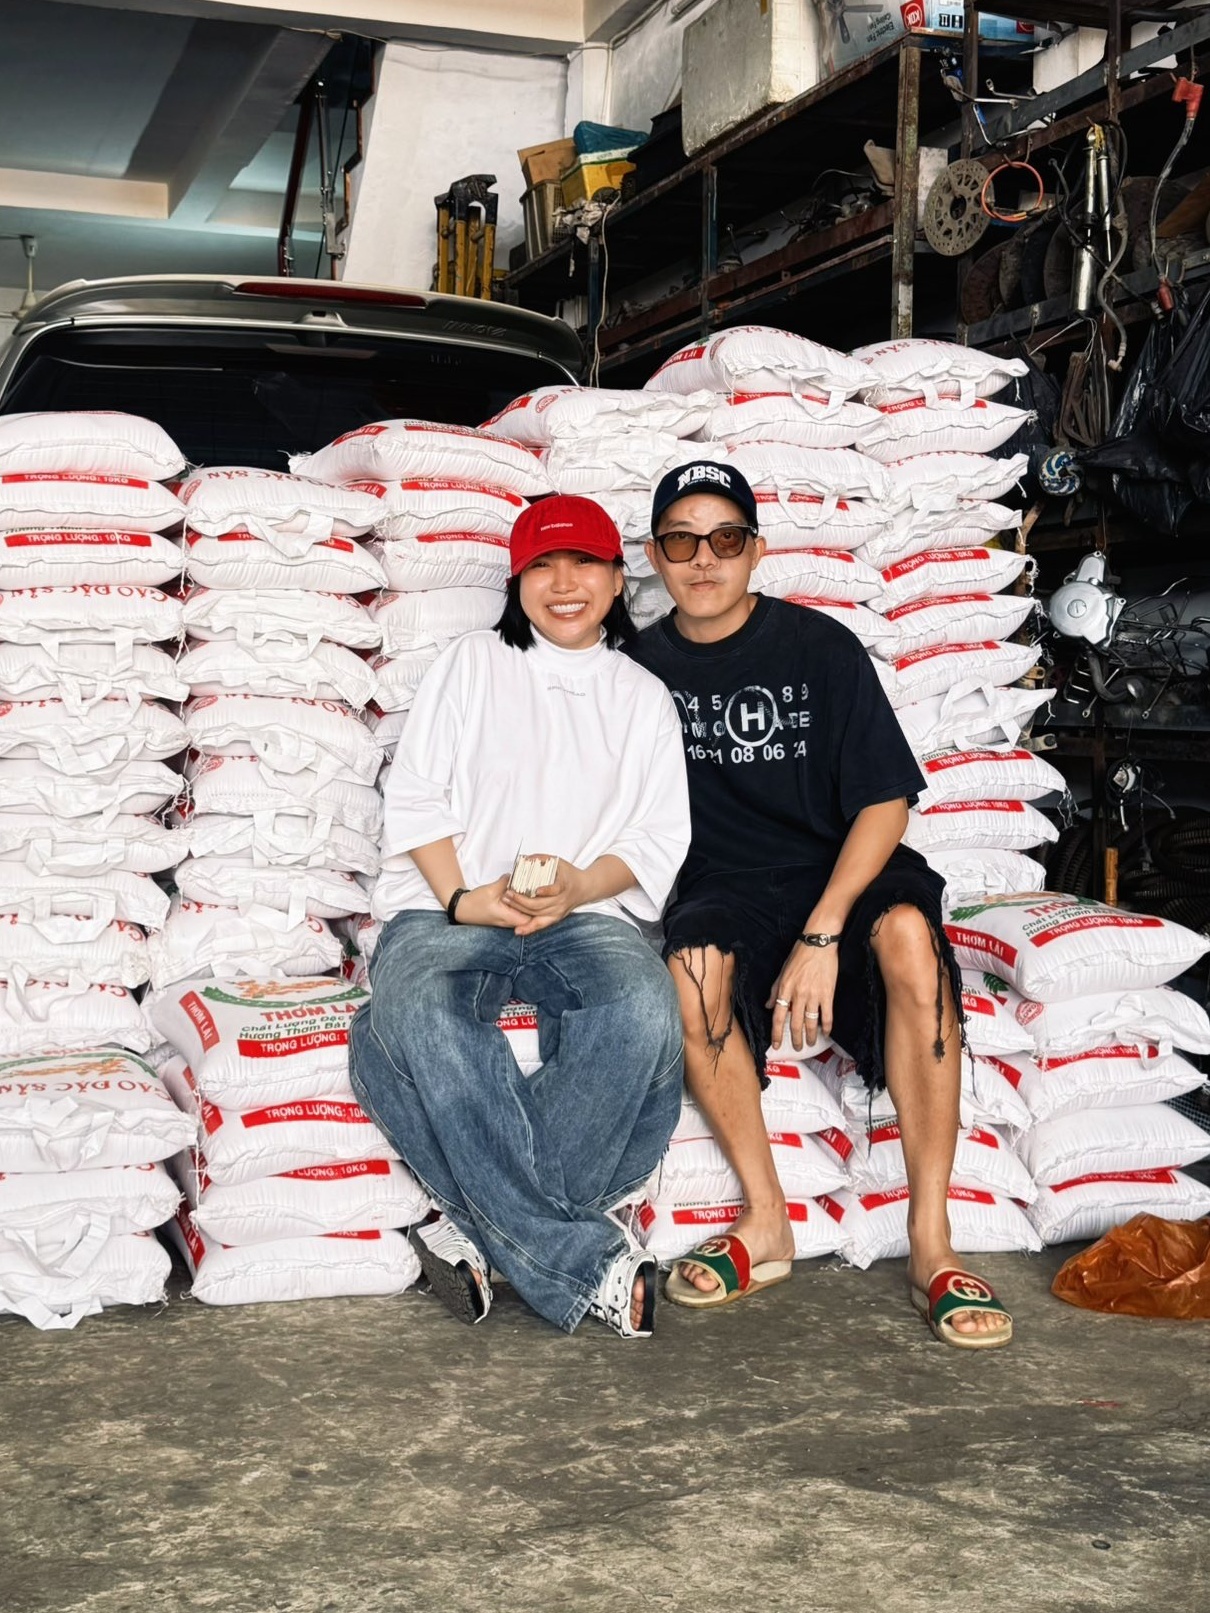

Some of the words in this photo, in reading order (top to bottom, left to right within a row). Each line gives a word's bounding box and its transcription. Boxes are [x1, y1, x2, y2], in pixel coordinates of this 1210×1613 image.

[906, 10, 920, 25] KDK
[677, 465, 731, 491] NBSC
[956, 932, 986, 948] THƠM
[260, 1003, 326, 1022] THƠM
[239, 1030, 281, 1040] Hương
[286, 1025, 321, 1036] Thơm
[242, 1024, 272, 1032] Chất
[275, 1019, 316, 1029] Lượng
[260, 1039, 297, 1055] TRỌNG
[300, 1033, 340, 1047] LƯỢNG:
[266, 1105, 303, 1120] TRỌNG
[305, 1103, 346, 1119] LƯỢNG:
[341, 1163, 368, 1174] 10KG
[692, 1208, 726, 1222] TRỌNG
